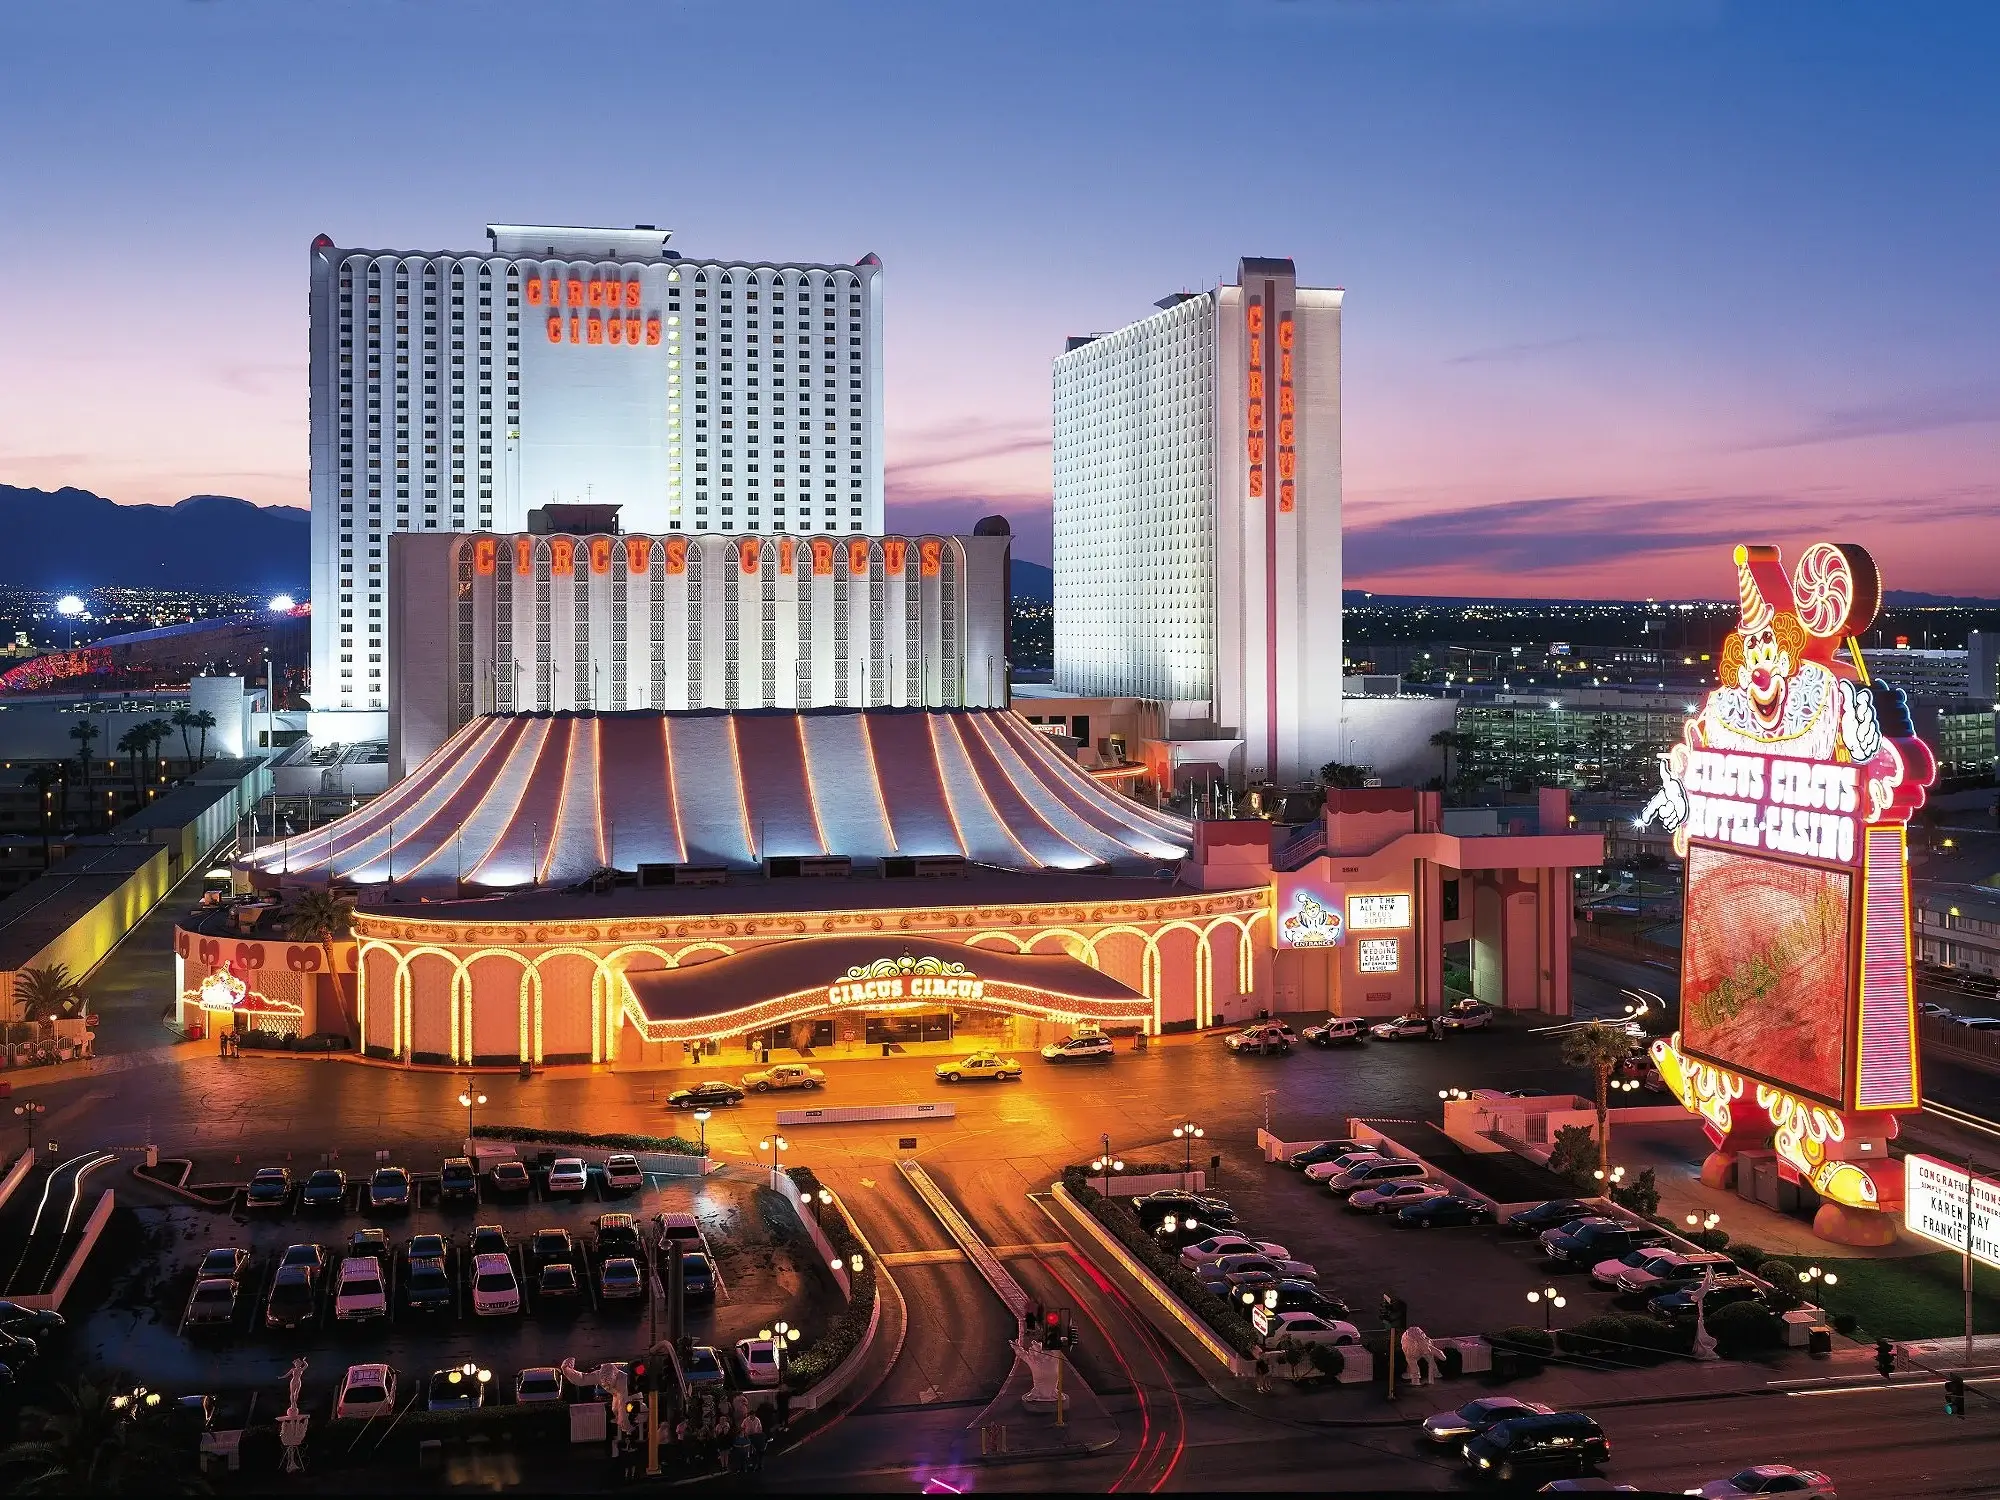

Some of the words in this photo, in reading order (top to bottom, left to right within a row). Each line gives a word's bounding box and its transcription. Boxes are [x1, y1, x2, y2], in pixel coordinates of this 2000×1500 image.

[527, 279, 640, 307] CIRCUS
[547, 317, 661, 345] CIRCUS
[1248, 304, 1264, 497] CIRCUS
[1279, 320, 1295, 513] CIRCUS
[474, 538, 686, 577] CIRCUS
[739, 538, 942, 577] CIRCUS
[1686, 750, 1765, 800] CIRCUS
[1771, 759, 1860, 813] CIRCUS
[1362, 947, 1396, 955] WEDDING
[1380, 940, 1396, 948] NEW
[828, 980, 904, 1005] CIRCUS
[910, 977, 984, 1000] CIRCUS
[1931, 1196, 1963, 1220] KAREN
[1970, 1211, 1990, 1231] RAY
[1923, 1215, 1962, 1243] FRANKIE
